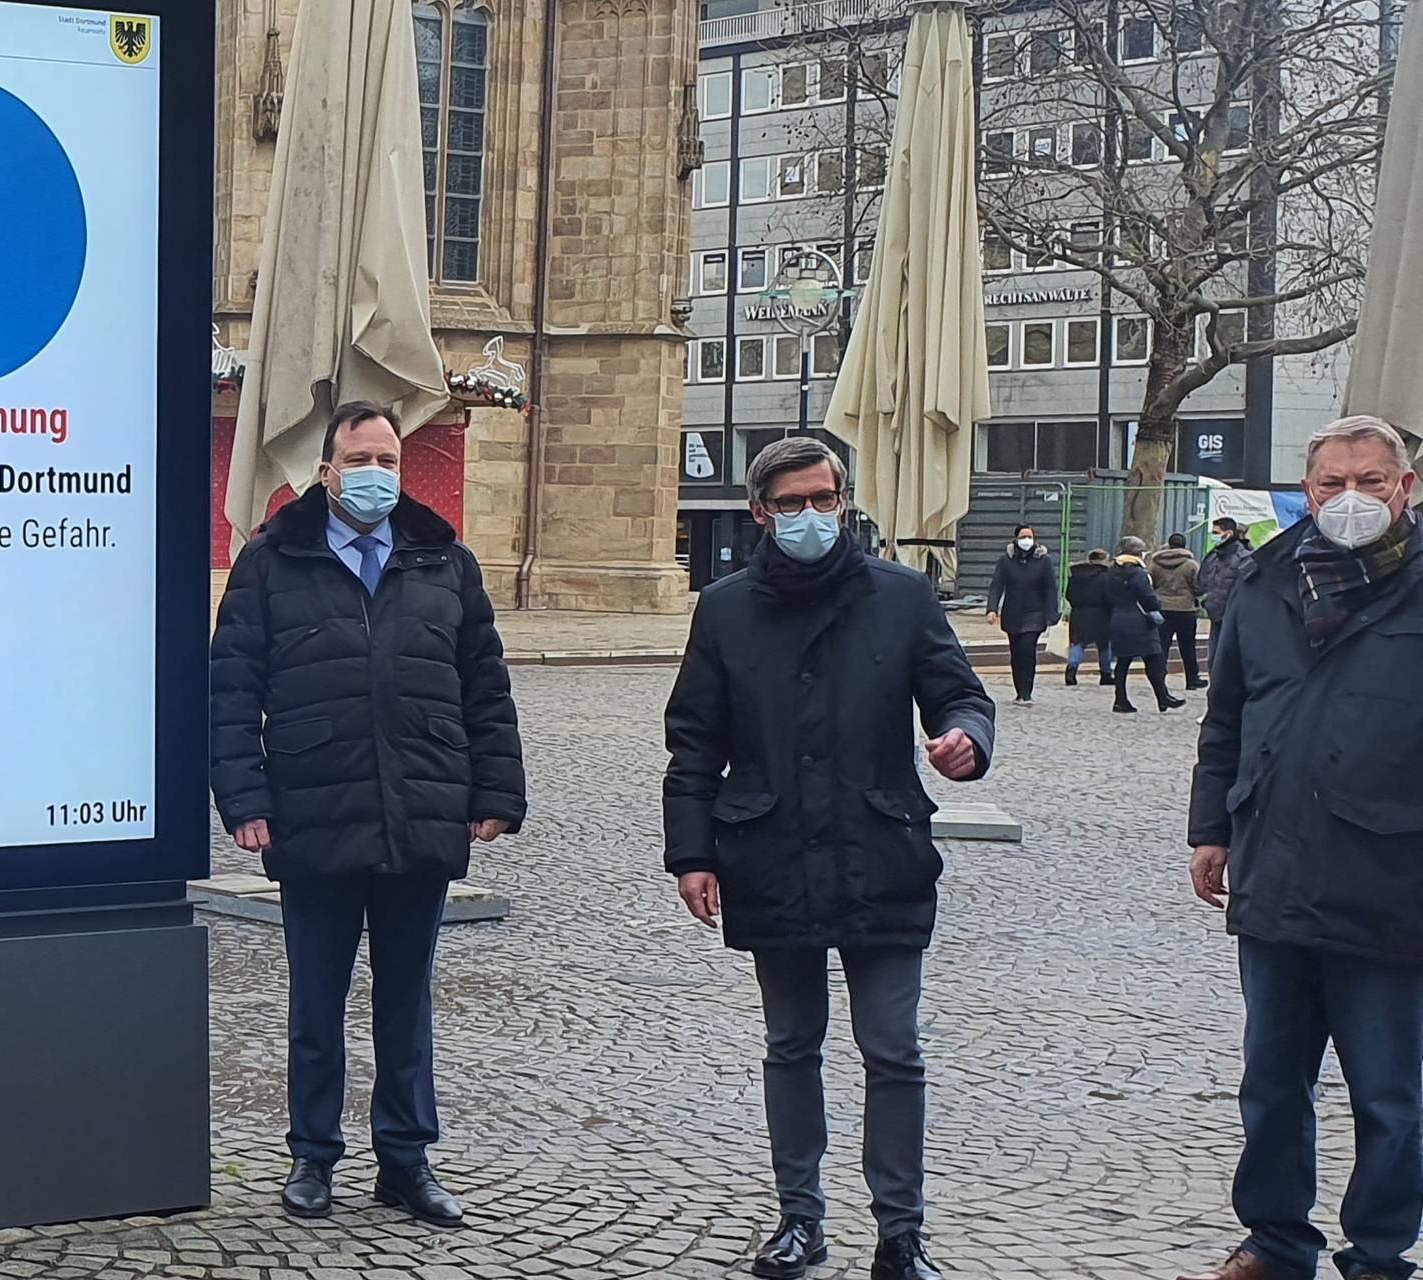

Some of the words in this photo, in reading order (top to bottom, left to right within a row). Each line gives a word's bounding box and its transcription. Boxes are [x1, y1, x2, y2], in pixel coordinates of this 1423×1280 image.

[744, 303, 830, 321] WEIEMANN
[1198, 434, 1224, 450] GIS
[22, 517, 117, 549] Gefahr.
[46, 801, 105, 827] 11:03
[112, 799, 148, 823] Uhr
